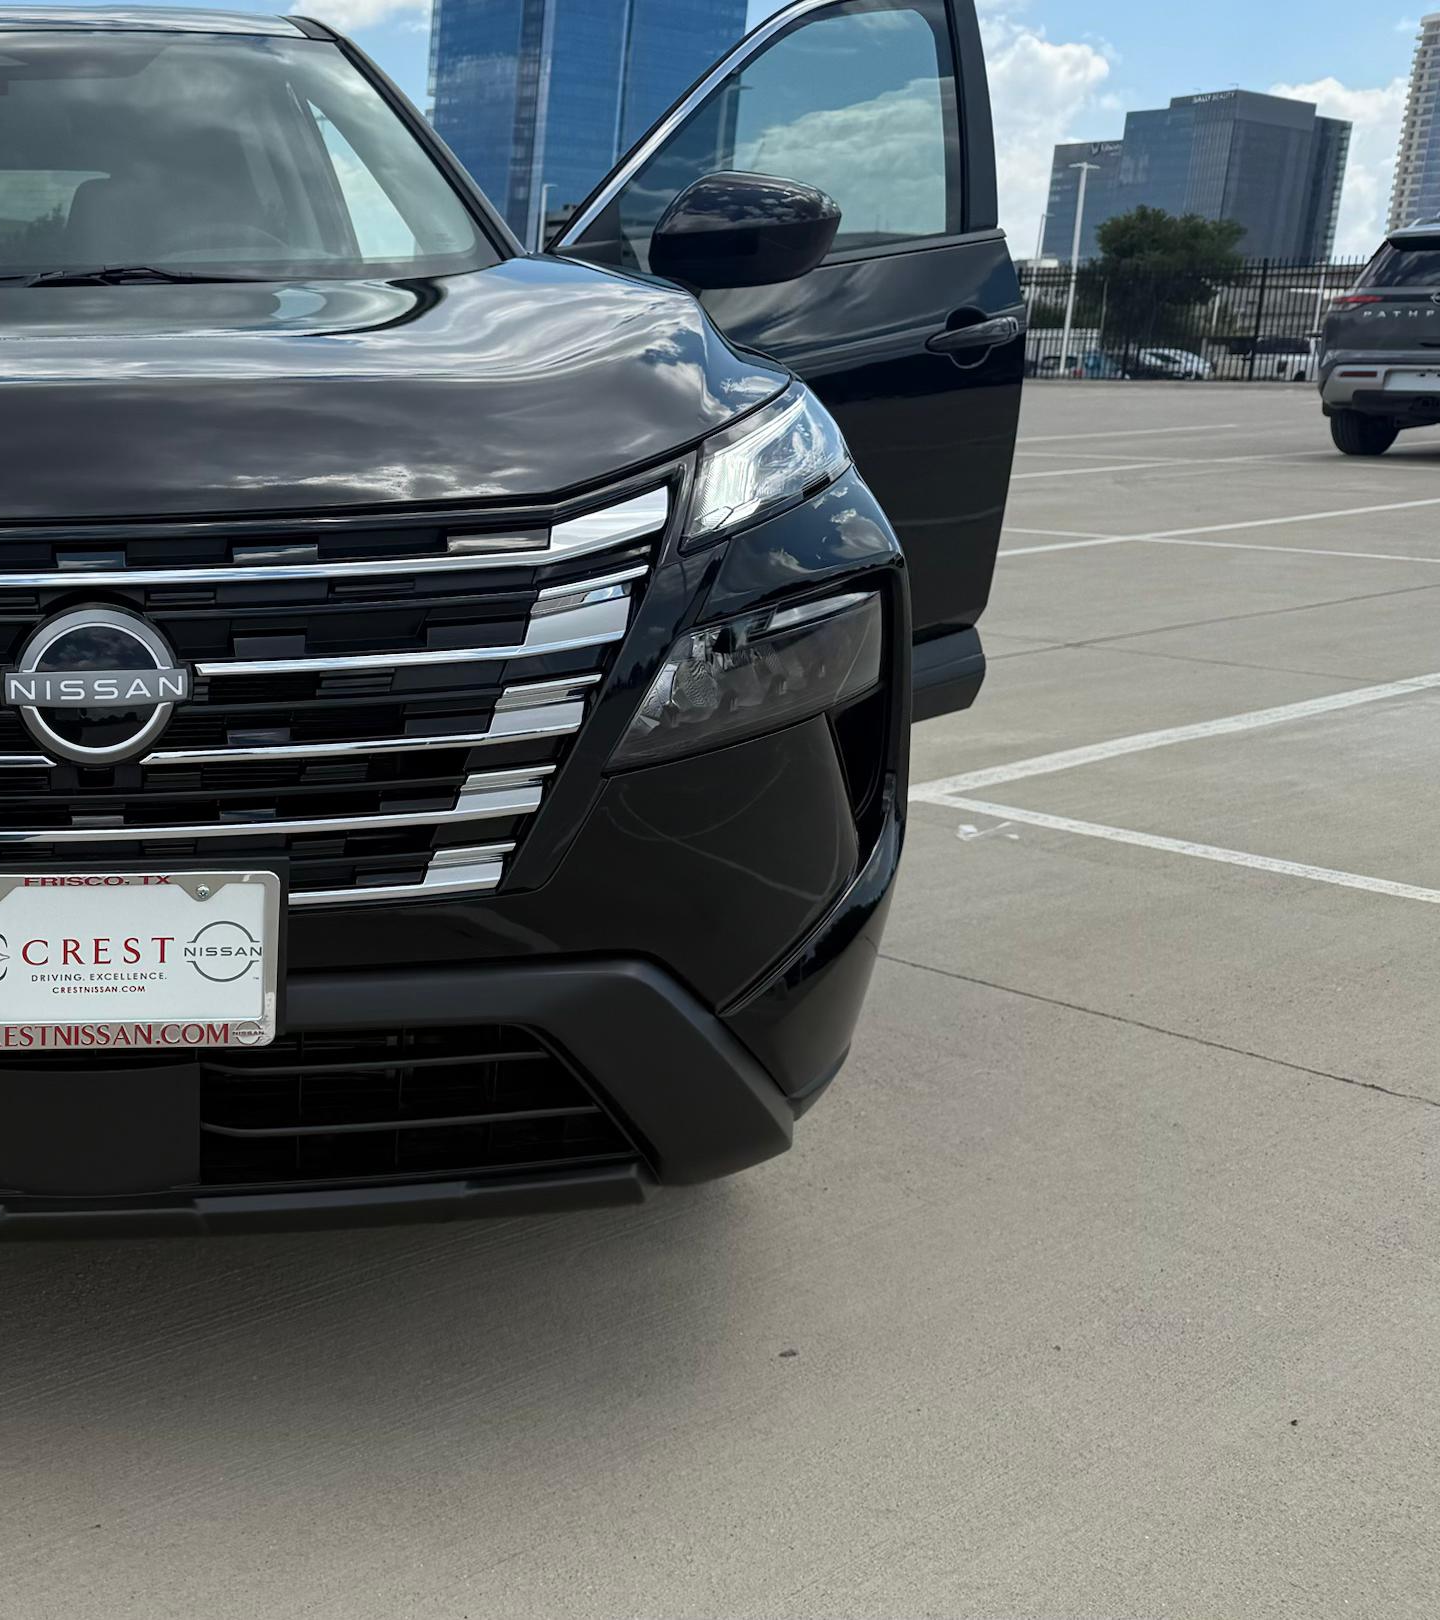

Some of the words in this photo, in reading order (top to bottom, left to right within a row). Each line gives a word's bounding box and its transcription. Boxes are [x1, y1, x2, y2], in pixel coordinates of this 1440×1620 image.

[10, 675, 183, 701] NISSAN
[138, 875, 172, 886] TX
[21, 937, 175, 966] CREST
[184, 946, 263, 957] NISSAN
[31, 973, 86, 982] DRIVING.
[89, 972, 168, 981] EXCELLENCE.
[52, 985, 146, 994] CRESTNISSAN.COM
